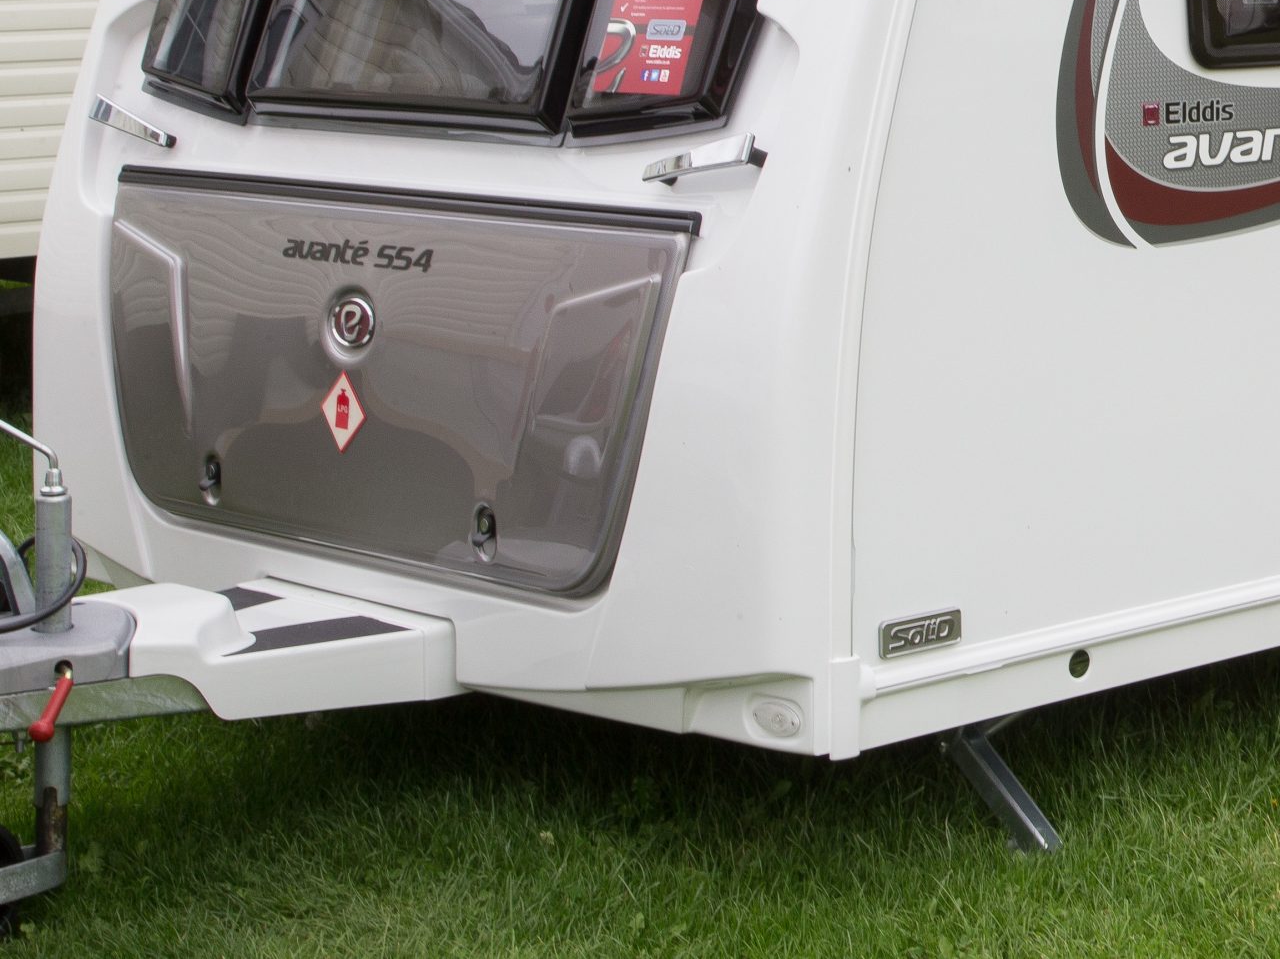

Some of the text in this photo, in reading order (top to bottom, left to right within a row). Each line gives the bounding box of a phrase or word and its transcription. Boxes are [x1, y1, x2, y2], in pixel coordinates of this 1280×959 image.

[649, 44, 682, 59] Elddis
[1165, 100, 1234, 124] Elddis
[282, 238, 434, 273] avanté 554
[337, 404, 348, 414] LPG
